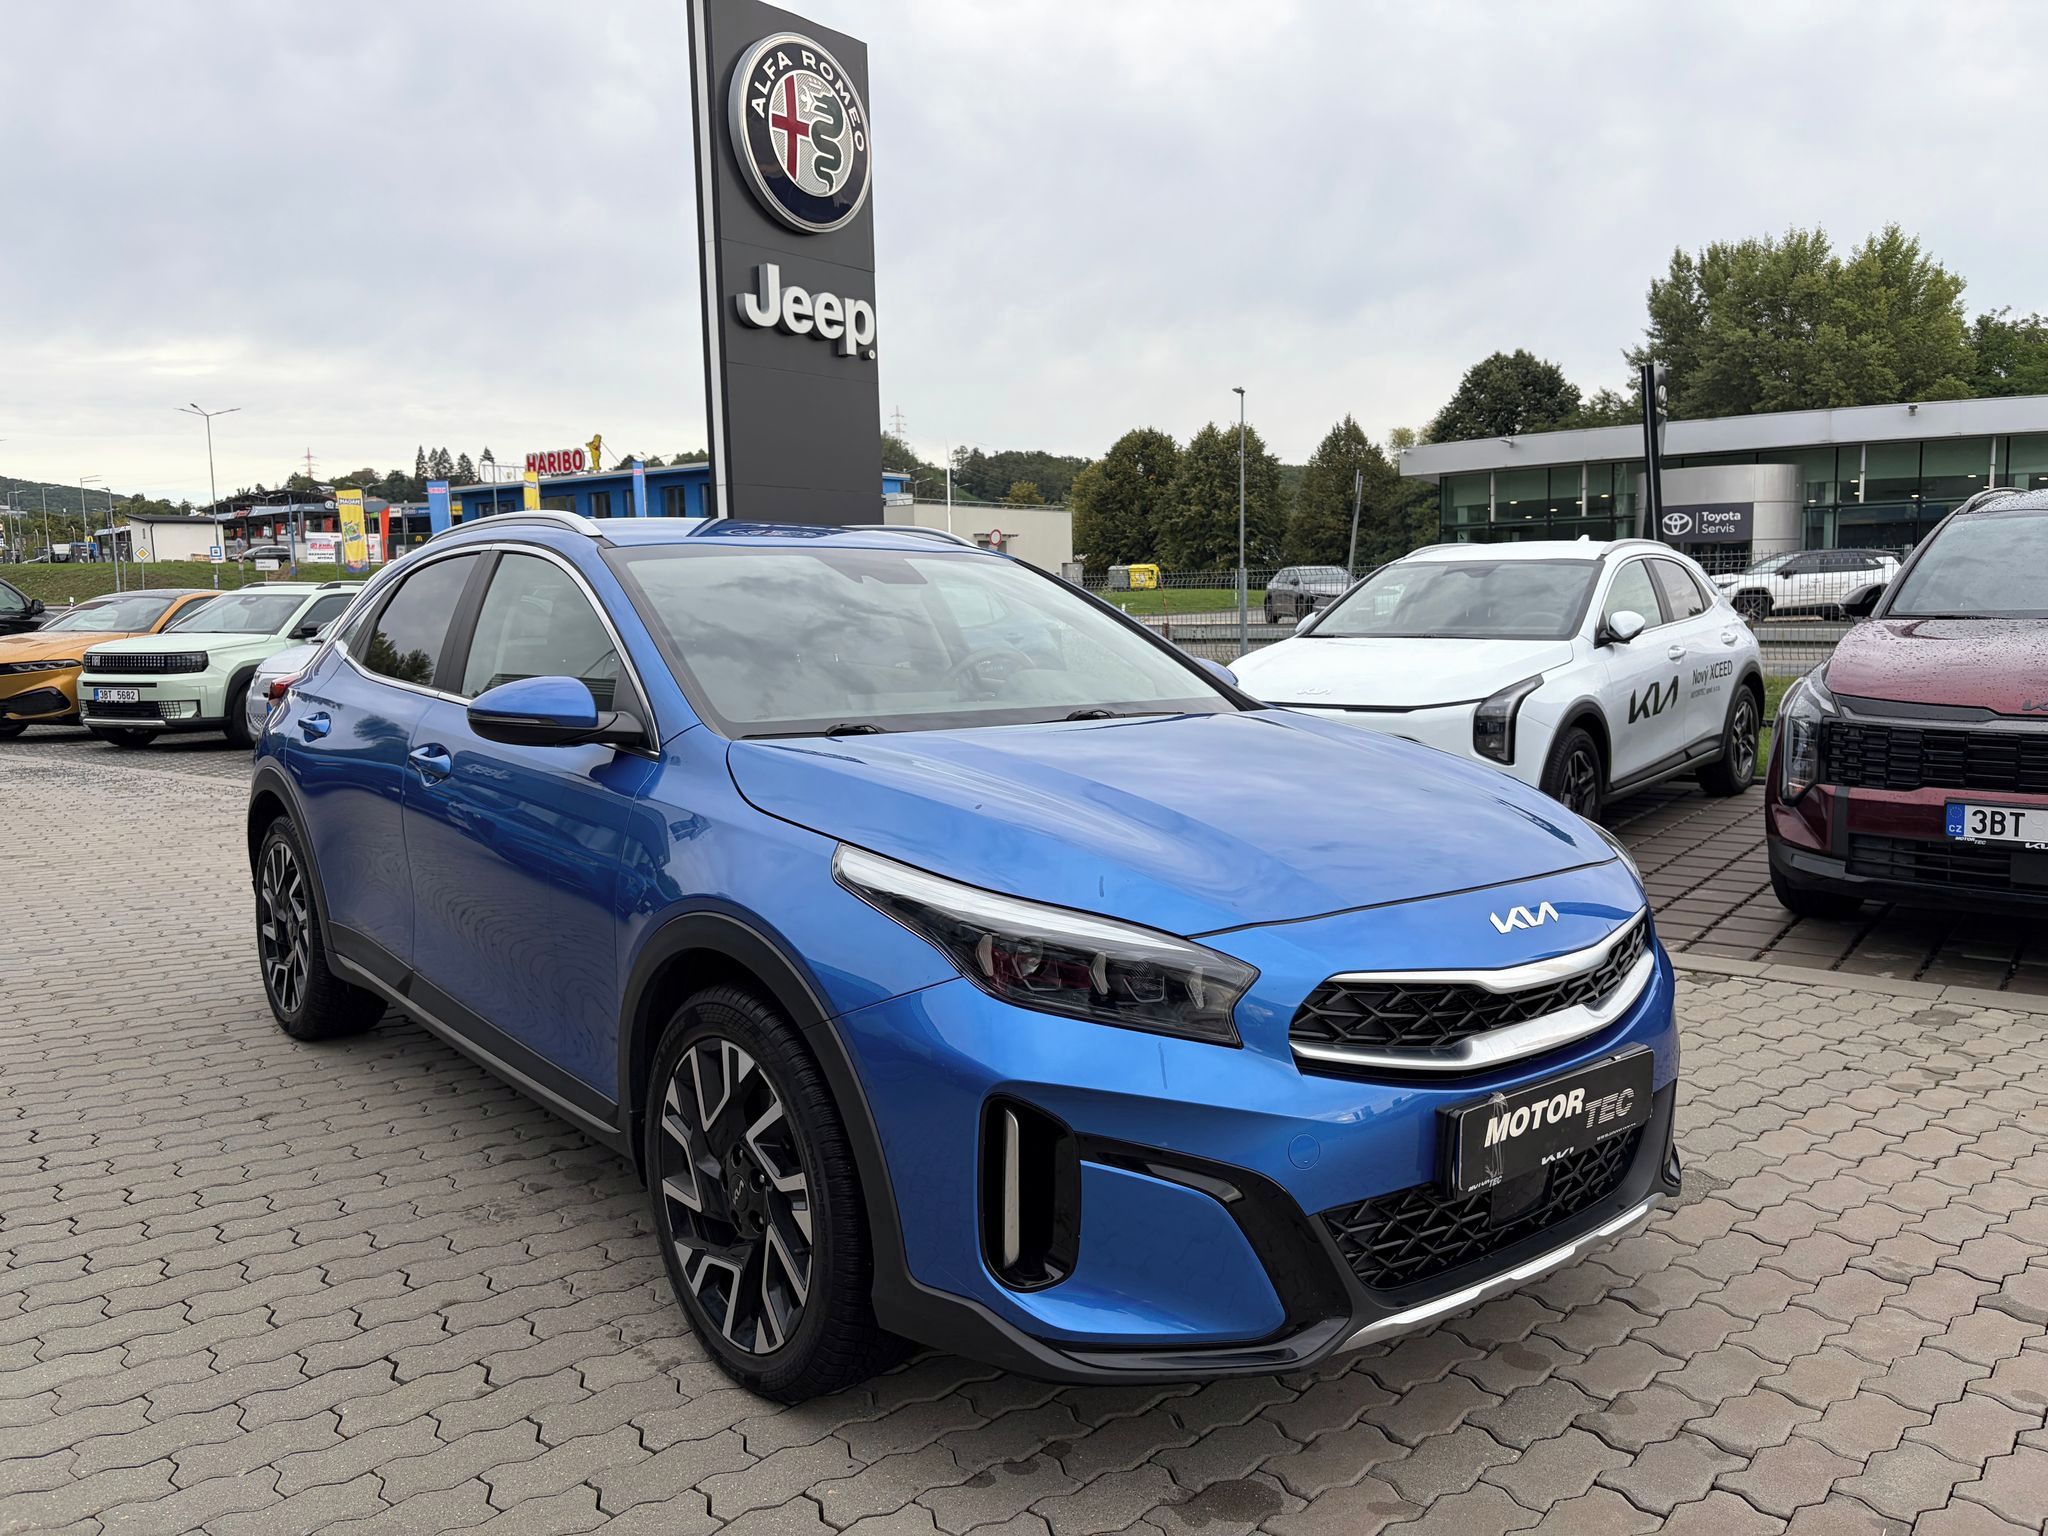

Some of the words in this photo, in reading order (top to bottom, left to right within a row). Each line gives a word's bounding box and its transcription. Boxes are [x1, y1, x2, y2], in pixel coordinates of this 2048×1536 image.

[751, 51, 793, 119] ALFA
[801, 50, 865, 152] ROMEO
[525, 448, 585, 474] HARIBO
[1701, 511, 1741, 523] Toyota
[1701, 523, 1735, 534] Servis
[1692, 666, 1709, 686] Nový
[1709, 660, 1733, 681] XCEED
[1628, 674, 1679, 724] KIA
[1948, 824, 1962, 833] CZ
[1971, 809, 2026, 838] 3BT
[1489, 901, 1559, 934] KIA
[1483, 1087, 1586, 1149] MOTOR
[1584, 1087, 1635, 1129] TEC
